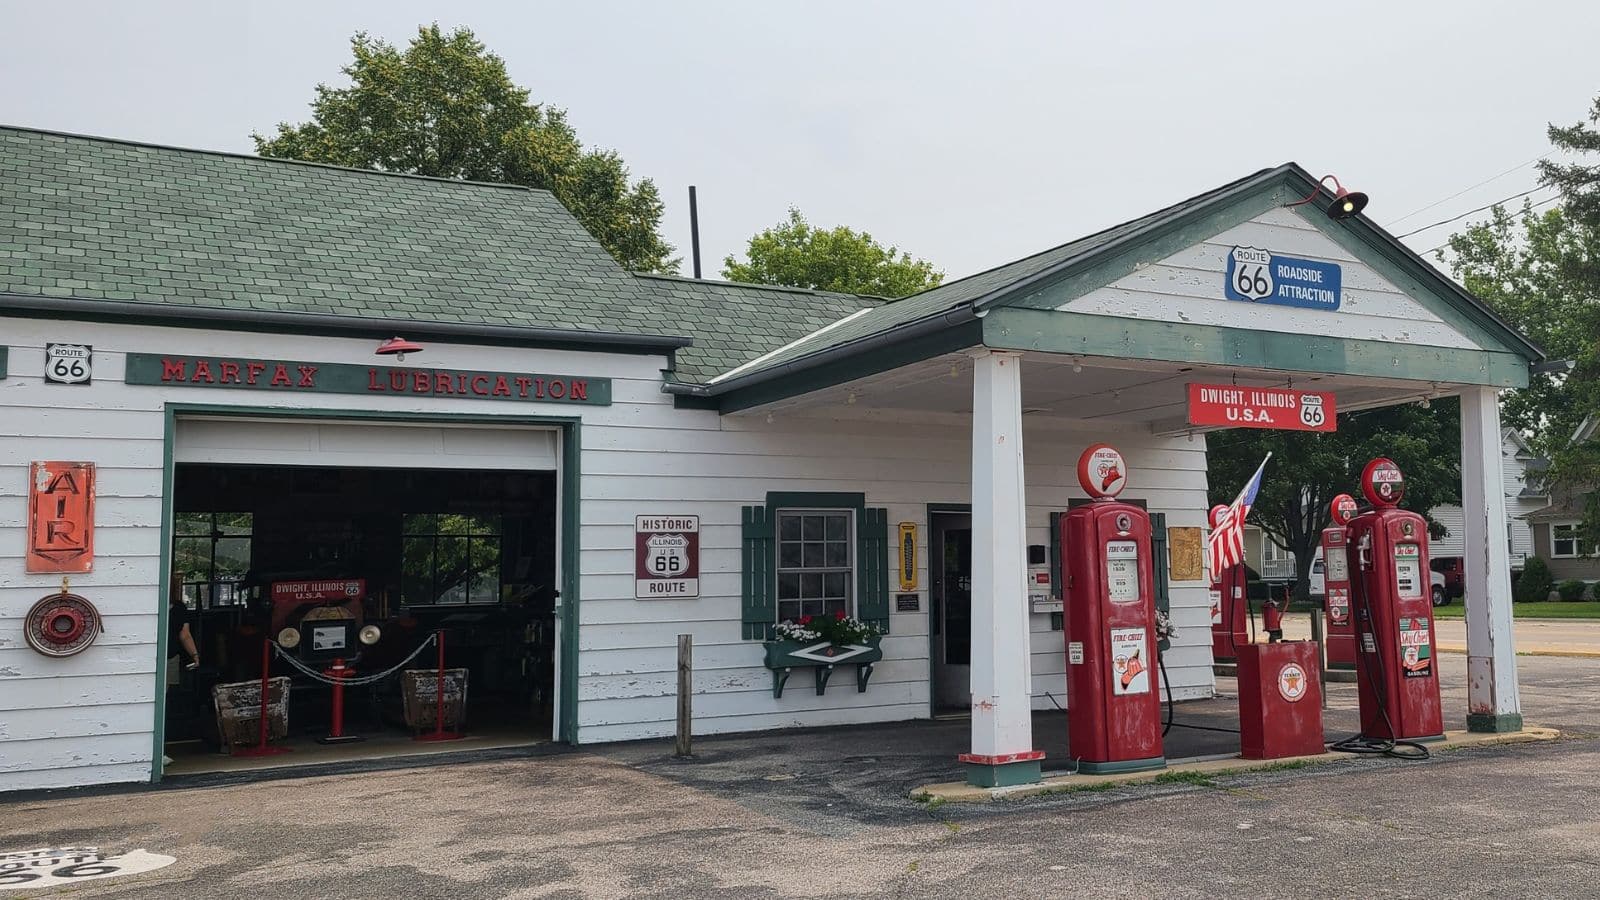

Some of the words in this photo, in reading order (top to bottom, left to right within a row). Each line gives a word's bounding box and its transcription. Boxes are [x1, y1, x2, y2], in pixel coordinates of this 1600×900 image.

[1237, 250, 1266, 262] ROUTE
[1237, 264, 1268, 295] 66
[1278, 265, 1323, 283] ROADSIDE
[1278, 284, 1335, 303] ATTRACTION
[55, 349, 84, 357] ROUTE
[54, 358, 84, 377] 66
[161, 358, 318, 388] MARFAX
[367, 368, 589, 400] LUBRICATION
[1200, 388, 1248, 406] DWIGHT,
[1251, 392, 1296, 409] ILLINOIS
[1303, 396, 1321, 404] ROUTE
[1226, 407, 1274, 423] U.S.A.
[1303, 406, 1322, 423] 66
[44, 471, 81, 545] AIR
[642, 519, 693, 530] HISTORIC
[655, 556, 680, 572] 66
[311, 582, 345, 592] ILLINOIS
[649, 582, 686, 593] ROUTE
[1401, 631, 1413, 644] Sky
